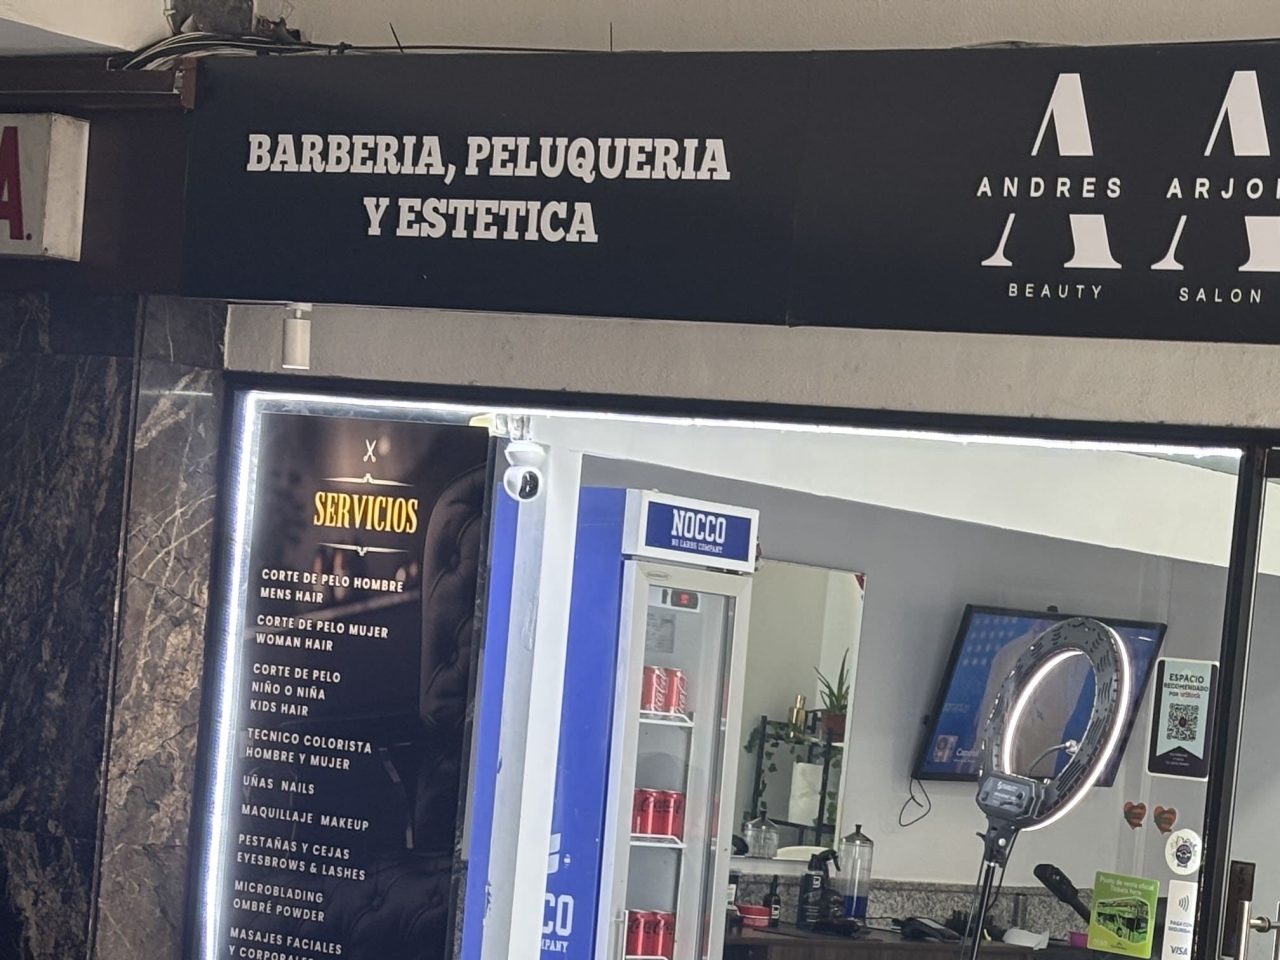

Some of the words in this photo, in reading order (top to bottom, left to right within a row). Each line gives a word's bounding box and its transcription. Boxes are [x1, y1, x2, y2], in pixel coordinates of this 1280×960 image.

[246, 133, 457, 185] BARBERIA,
[465, 137, 730, 183] PELUQUERIA
[976, 176, 1122, 198] ANDRES
[363, 197, 390, 236] Y
[396, 197, 599, 243] ESTETICA
[1008, 283, 1103, 299] BEAUTY
[1178, 287, 1262, 303] SALON
[314, 491, 418, 534] SERVICIOS
[671, 509, 726, 544] NOCCO
[262, 569, 299, 582] CORTE
[303, 573, 317, 584] DE
[321, 574, 350, 587] PELO
[353, 577, 405, 593] HOMBRE
[261, 587, 292, 600] MENS
[296, 590, 324, 603] HAIR
[257, 615, 294, 628] CORTE
[298, 619, 312, 631] DE
[316, 621, 345, 634] PELO
[349, 624, 389, 638] MUJER
[256, 633, 301, 648] WOMAN
[305, 638, 333, 651] HAIR
[253, 663, 290, 678] CORTE
[294, 668, 309, 680] DE
[312, 670, 341, 683] PELO
[1169, 673, 1204, 684] ESPACIO
[252, 681, 281, 694] NIÑO
[285, 685, 293, 696] O
[297, 685, 326, 700] NIÑA
[250, 699, 277, 713] KIDS
[281, 703, 309, 716] HAIR
[248, 728, 300, 745] TECNICO
[304, 735, 372, 754] COLORISTA
[246, 747, 294, 763] HOMBRE
[299, 753, 305, 764] Y
[310, 755, 350, 770] MUJER
[243, 775, 274, 789] UÑAS
[281, 781, 315, 794] NAILS
[241, 804, 314, 824] MAQUILLAJE
[320, 815, 369, 831] MAKEUP
[239, 834, 297, 852] PESTAÑAS
[301, 843, 308, 854] Y
[312, 845, 350, 859] CEJAS
[237, 852, 305, 872] EYESBROWS
[310, 863, 317, 873] &
[322, 865, 366, 880] LASHES
[235, 880, 323, 903] MICROBLADING
[233, 898, 272, 913] OMBRÉ
[276, 904, 325, 922] POWDER
[229, 945, 235, 956] Y
[230, 927, 283, 945] MASAJES
[287, 936, 342, 955] FACIALES
[1170, 945, 1188, 955] VISA
